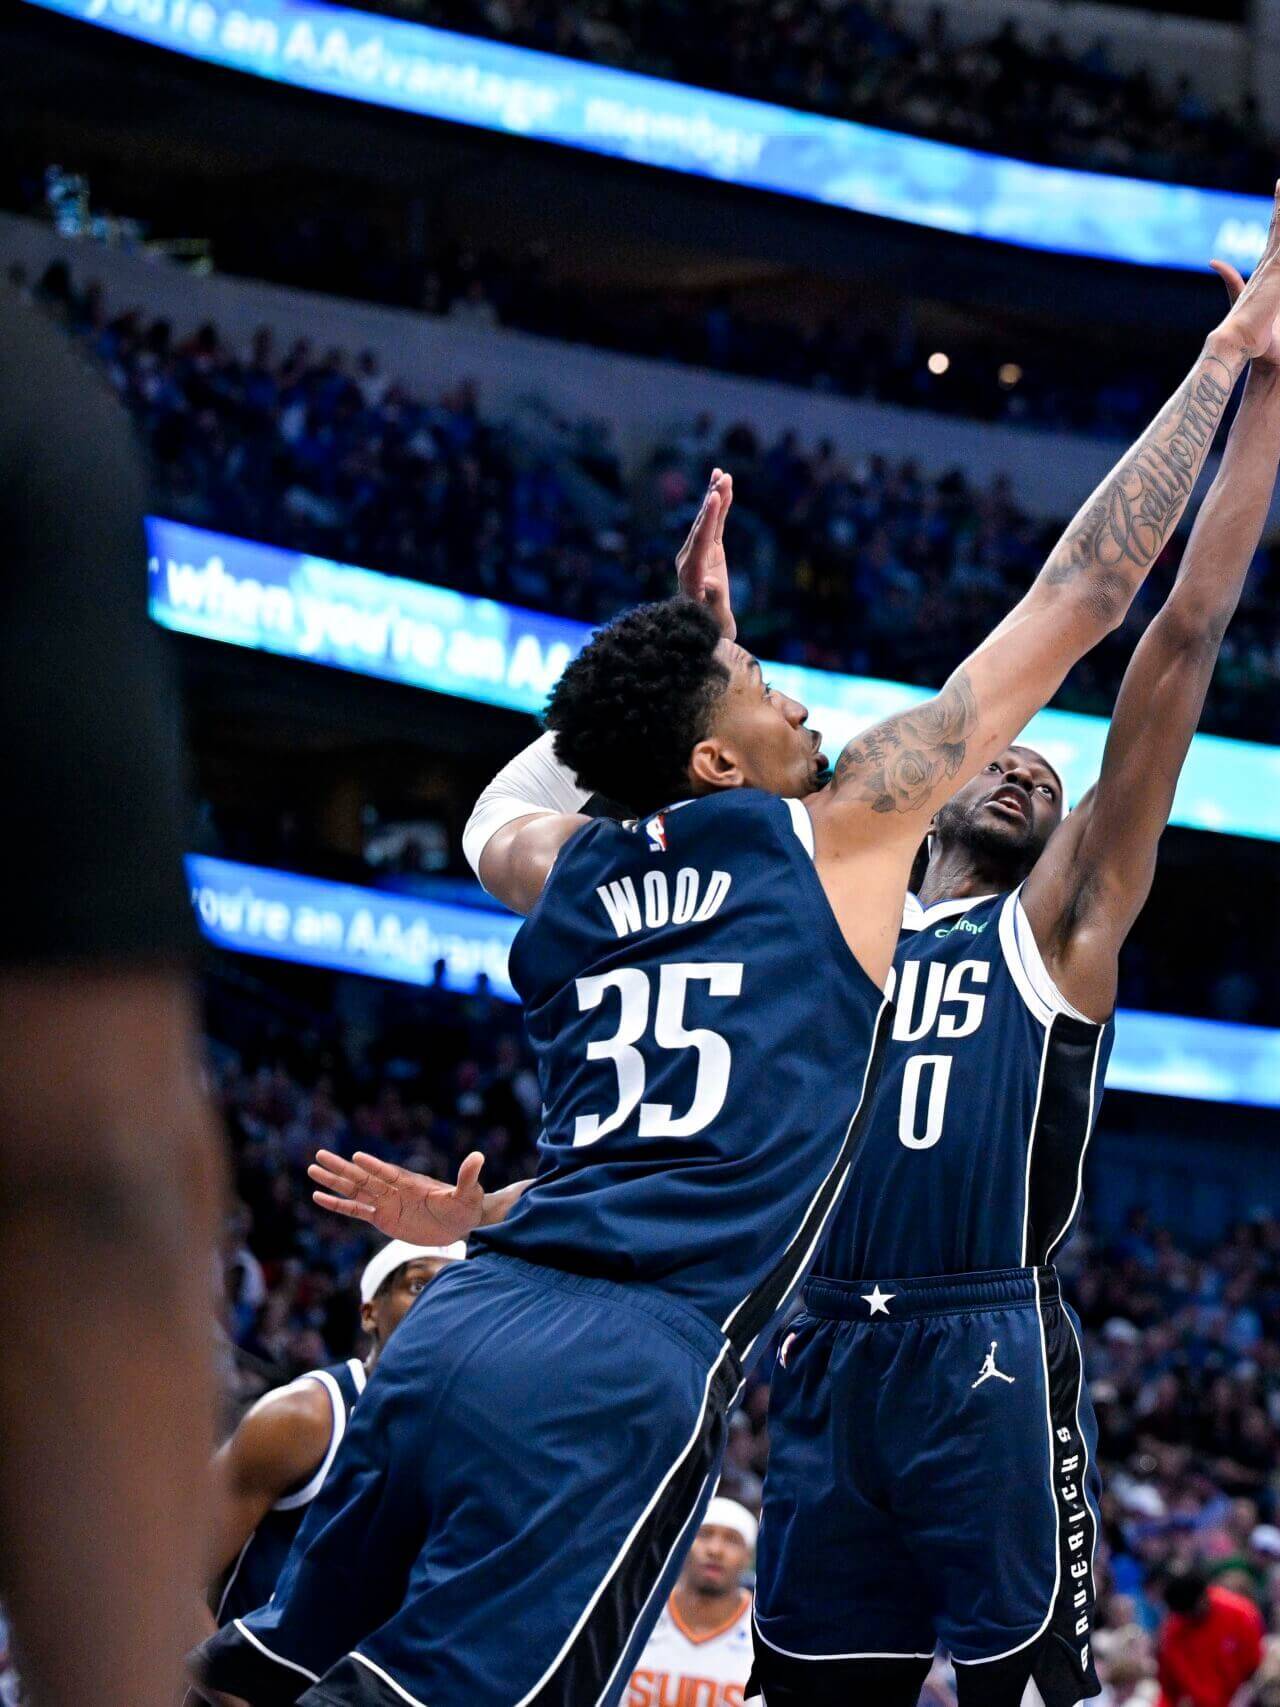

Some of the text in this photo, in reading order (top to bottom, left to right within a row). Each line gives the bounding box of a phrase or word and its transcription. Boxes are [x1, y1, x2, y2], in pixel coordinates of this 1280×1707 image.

[167, 555, 294, 633] when
[300, 595, 446, 669] you're
[446, 630, 505, 682] an
[293, 906, 344, 949] an
[596, 867, 732, 938] WOOD
[572, 963, 744, 1147] 35
[898, 1054, 953, 1150] 0
